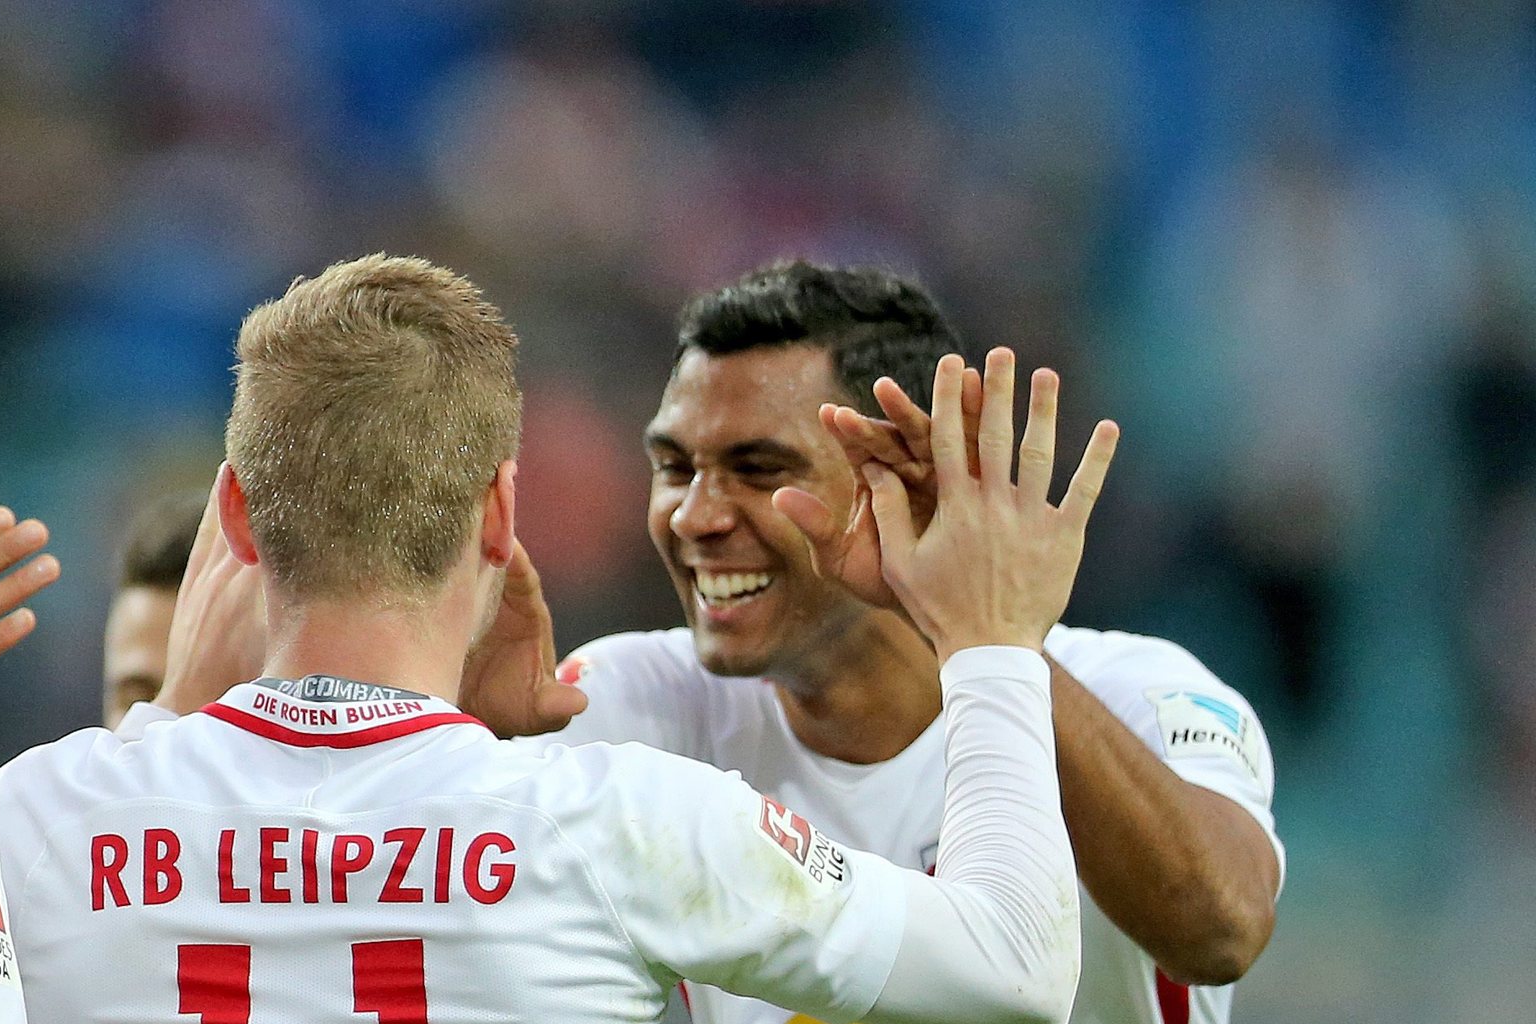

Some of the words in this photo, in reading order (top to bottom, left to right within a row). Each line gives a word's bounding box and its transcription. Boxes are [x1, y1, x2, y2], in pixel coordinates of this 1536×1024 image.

[253, 693, 276, 715] DIE
[280, 703, 337, 726] ROTEN
[346, 701, 423, 724] BULLEN
[91, 827, 183, 912] RB
[218, 827, 517, 905] LEIPZIG
